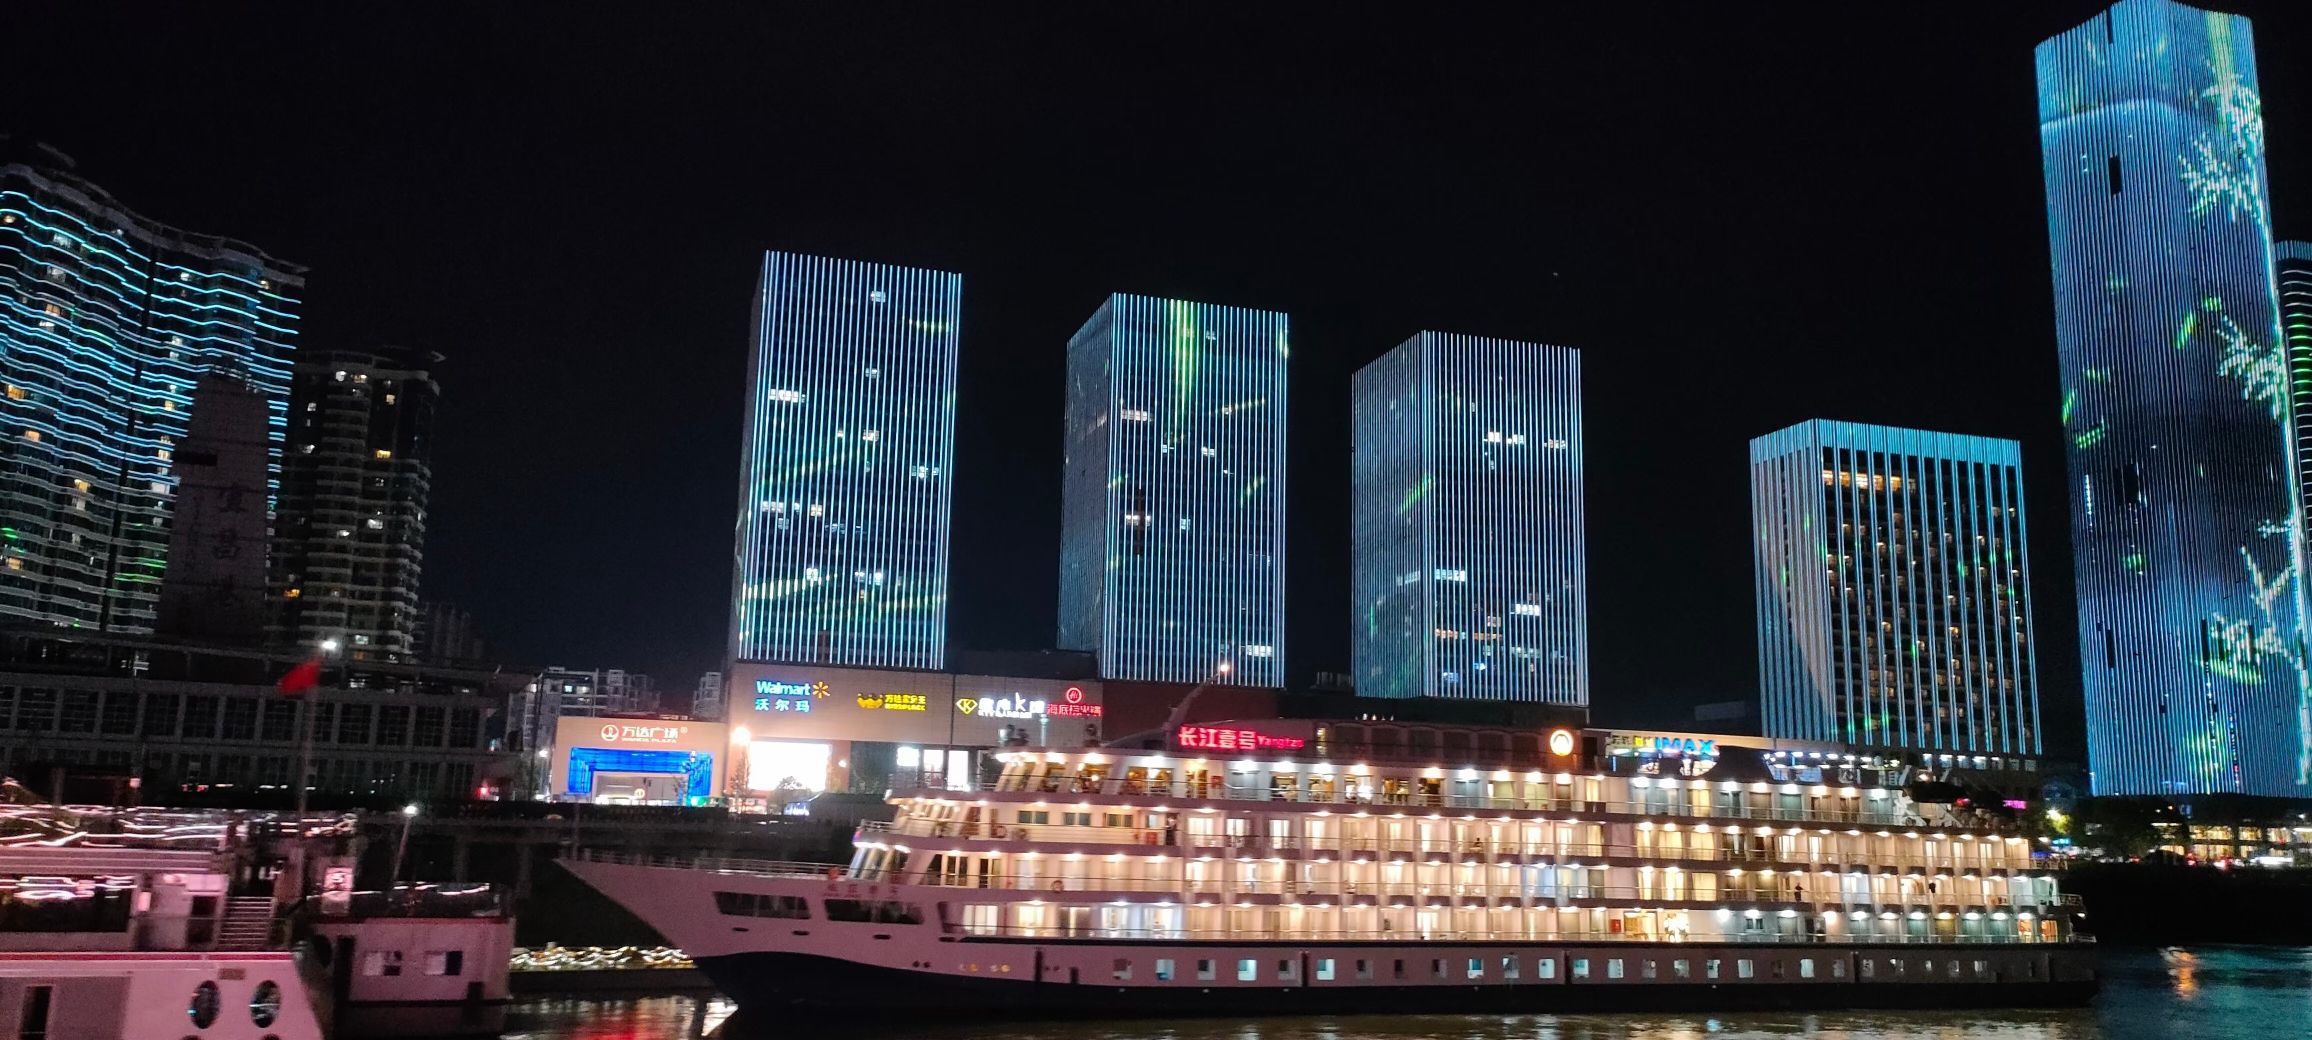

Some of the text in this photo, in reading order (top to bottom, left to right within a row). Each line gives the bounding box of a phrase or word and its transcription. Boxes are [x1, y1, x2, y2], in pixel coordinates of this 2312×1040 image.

[756, 681, 810, 696] Walmart
[755, 698, 810, 713] 沃尔玛
[1046, 703, 1101, 716] 海底捞火锅
[622, 726, 679, 738] 万达广场
[1179, 726, 1257, 749] 长江壹号
[1655, 737, 1715, 753] IMAX
